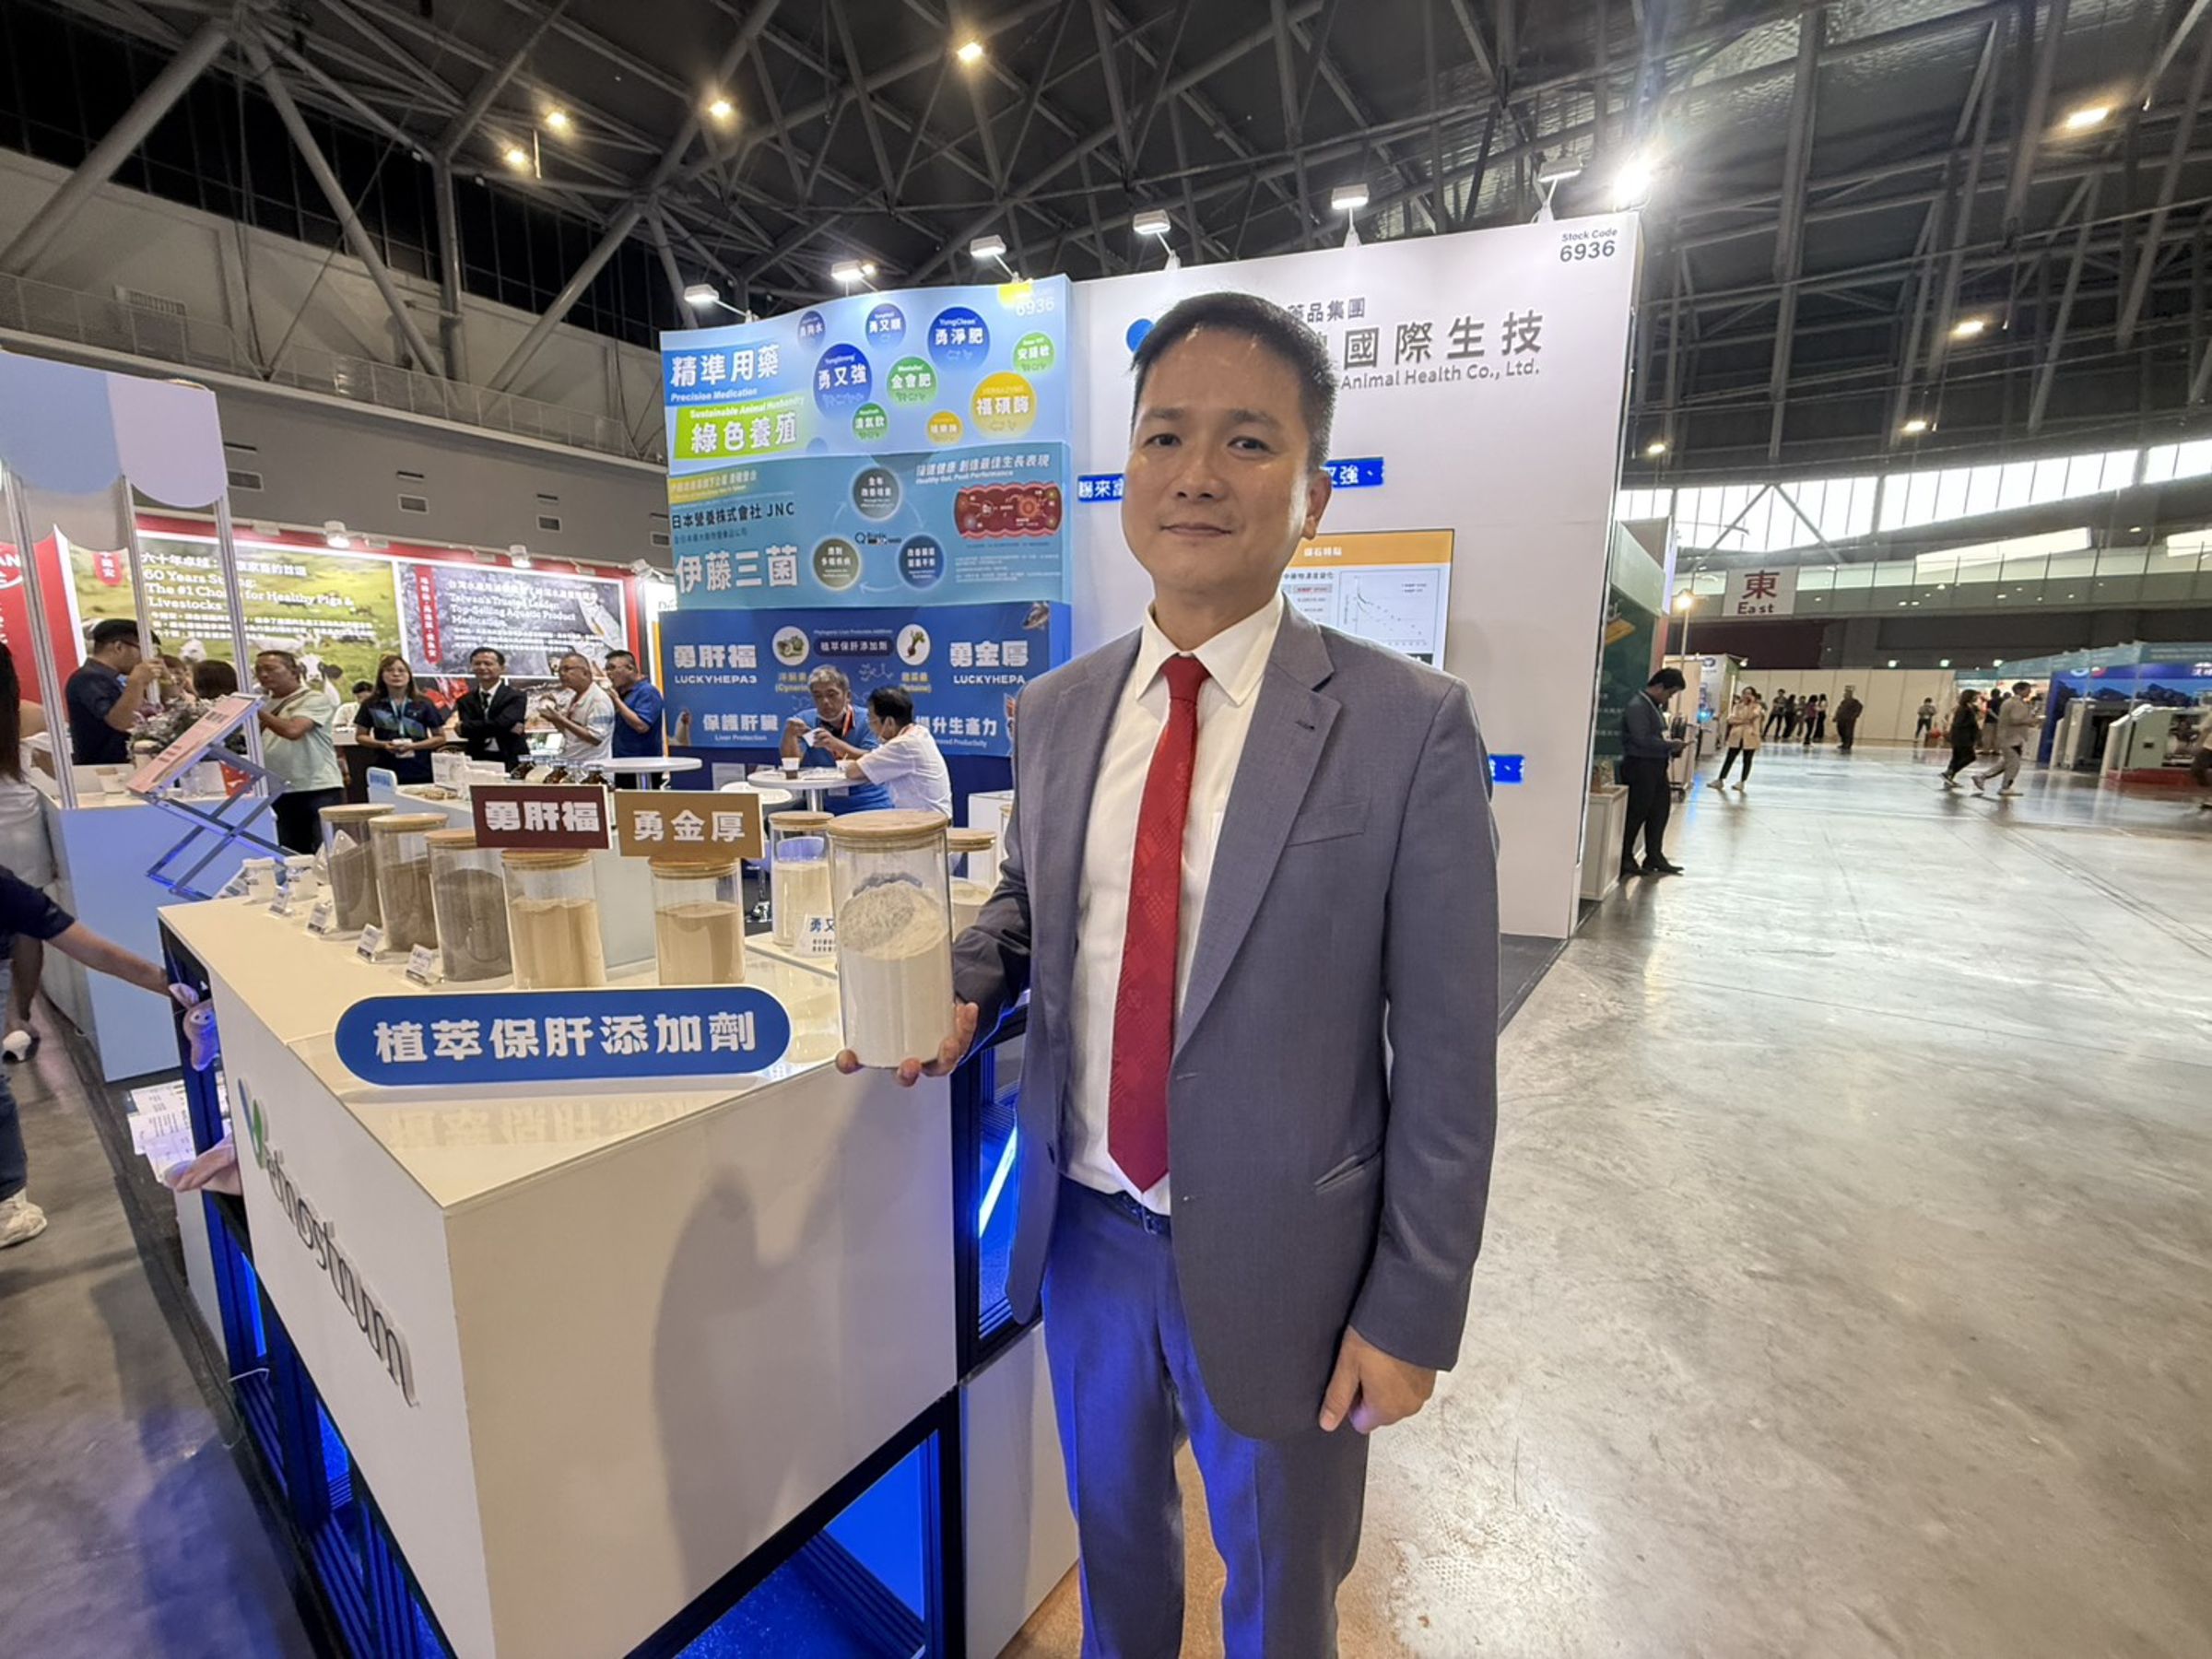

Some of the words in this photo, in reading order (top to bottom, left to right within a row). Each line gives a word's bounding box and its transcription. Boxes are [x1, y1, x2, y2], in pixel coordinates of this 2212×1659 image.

[1561, 230, 1590, 242] Stock
[1592, 227, 1618, 239] Code
[1560, 239, 1616, 263] 6936
[1016, 297, 1055, 316] 6936
[1318, 309, 1544, 371] 國際生技
[670, 344, 780, 388] 精準用藥
[818, 364, 867, 391] 勇又強
[1340, 370, 1400, 391] Animal
[1405, 365, 1462, 385] Health
[1466, 363, 1500, 381] Co.,
[1506, 358, 1540, 376] Ltd.
[670, 393, 712, 403] Precision
[712, 387, 759, 399] Medication
[690, 406, 738, 418] Sustainable
[739, 404, 767, 415] Animal
[690, 412, 797, 454] 綠色養殖
[766, 502, 795, 518] JNC
[144, 570, 165, 582] 60
[166, 571, 206, 585] Years
[675, 545, 798, 594] 伊藤三菌
[146, 582, 175, 595] The
[176, 584, 194, 596] #1
[195, 585, 242, 600] Choi
[244, 588, 265, 600] for
[266, 591, 317, 608] Healthy
[317, 595, 346, 608] Pigs
[1742, 570, 1780, 599] 東
[148, 597, 223, 612] Livestocks
[450, 592, 492, 606] Taiwan's
[1737, 601, 1774, 615] East
[451, 604, 506, 618] Top-Selling
[506, 608, 542, 621] Aquatic
[543, 610, 577, 623] Product
[674, 644, 758, 669] 勇肝福
[949, 640, 1030, 668] 勇金厚
[675, 675, 758, 684] LUCKYHEPA3
[953, 674, 1027, 685] LUCKYHEPA
[485, 800, 600, 832] 勇肝福
[633, 808, 746, 842] 勇金厚
[372, 1010, 757, 1065] 植萃保肝添加劑
